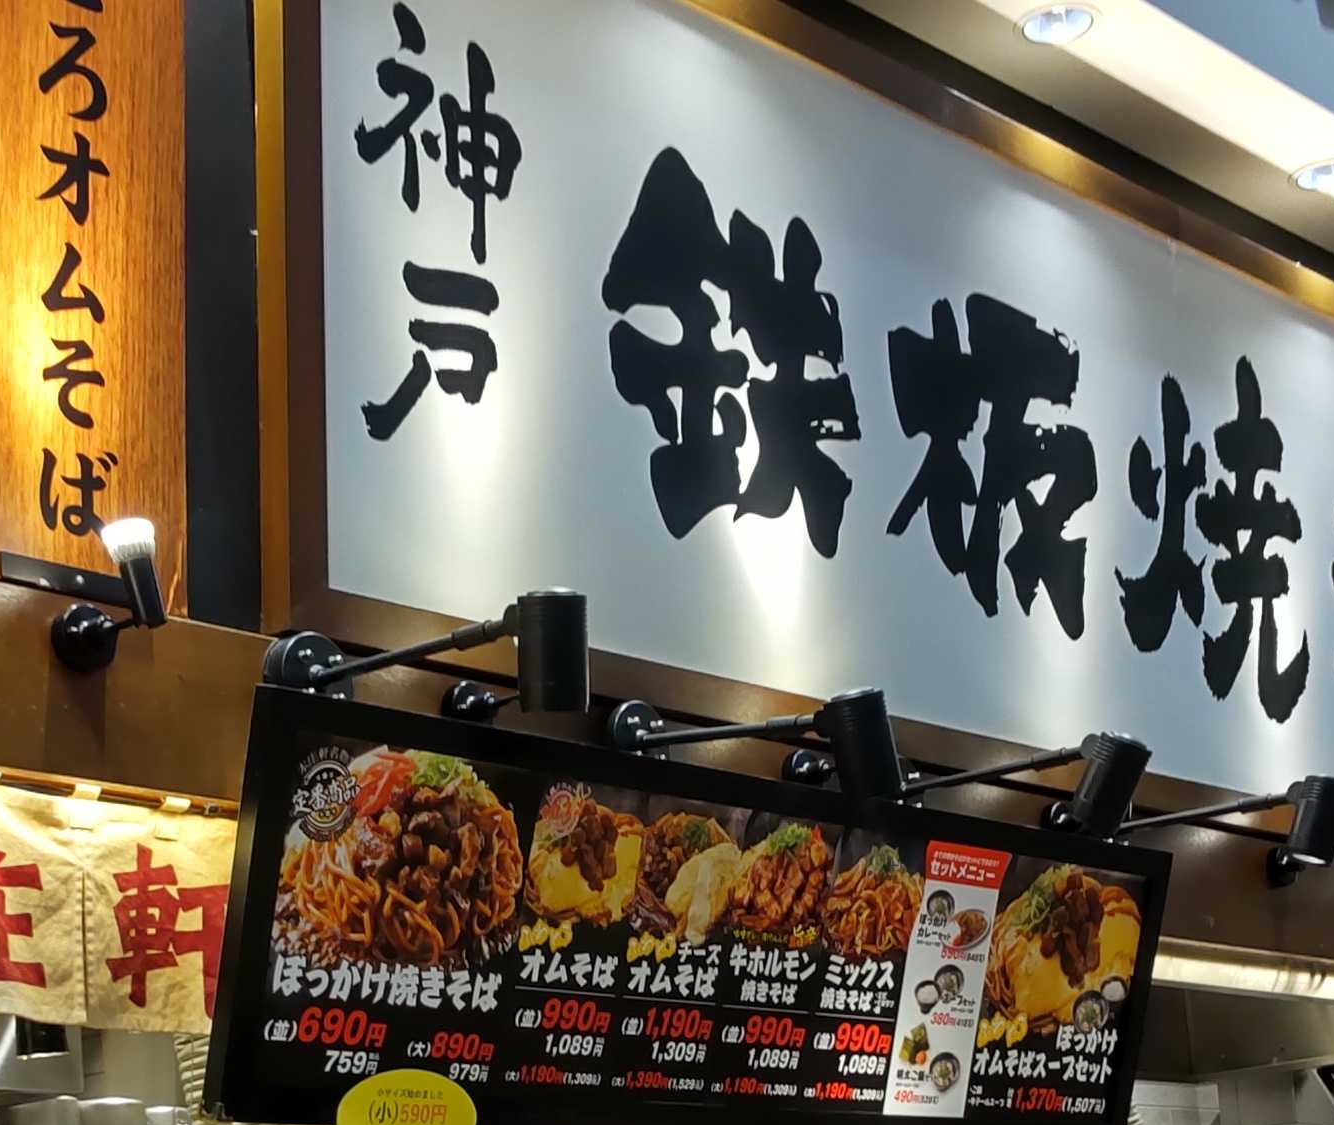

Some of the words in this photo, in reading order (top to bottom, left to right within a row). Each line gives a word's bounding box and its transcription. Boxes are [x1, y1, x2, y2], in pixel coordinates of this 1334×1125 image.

[354, 2, 522, 441] 神戸
[38, 0, 118, 537] ろオムそば
[930, 860, 996, 882] セットメニュー
[519, 948, 619, 988] オムそば
[678, 941, 722, 966] チーズ
[730, 943, 817, 982] 牛ホルモン
[824, 954, 895, 990] ミックス
[272, 954, 503, 1013] ぼっかけ焼きそば
[627, 960, 719, 998] オムそば
[740, 979, 798, 1005] 焼きそば
[820, 987, 873, 1012] 焼きそば
[1056, 1024, 1118, 1055] ぼっかけ
[972, 1047, 1113, 1085] オムそばスープセット
